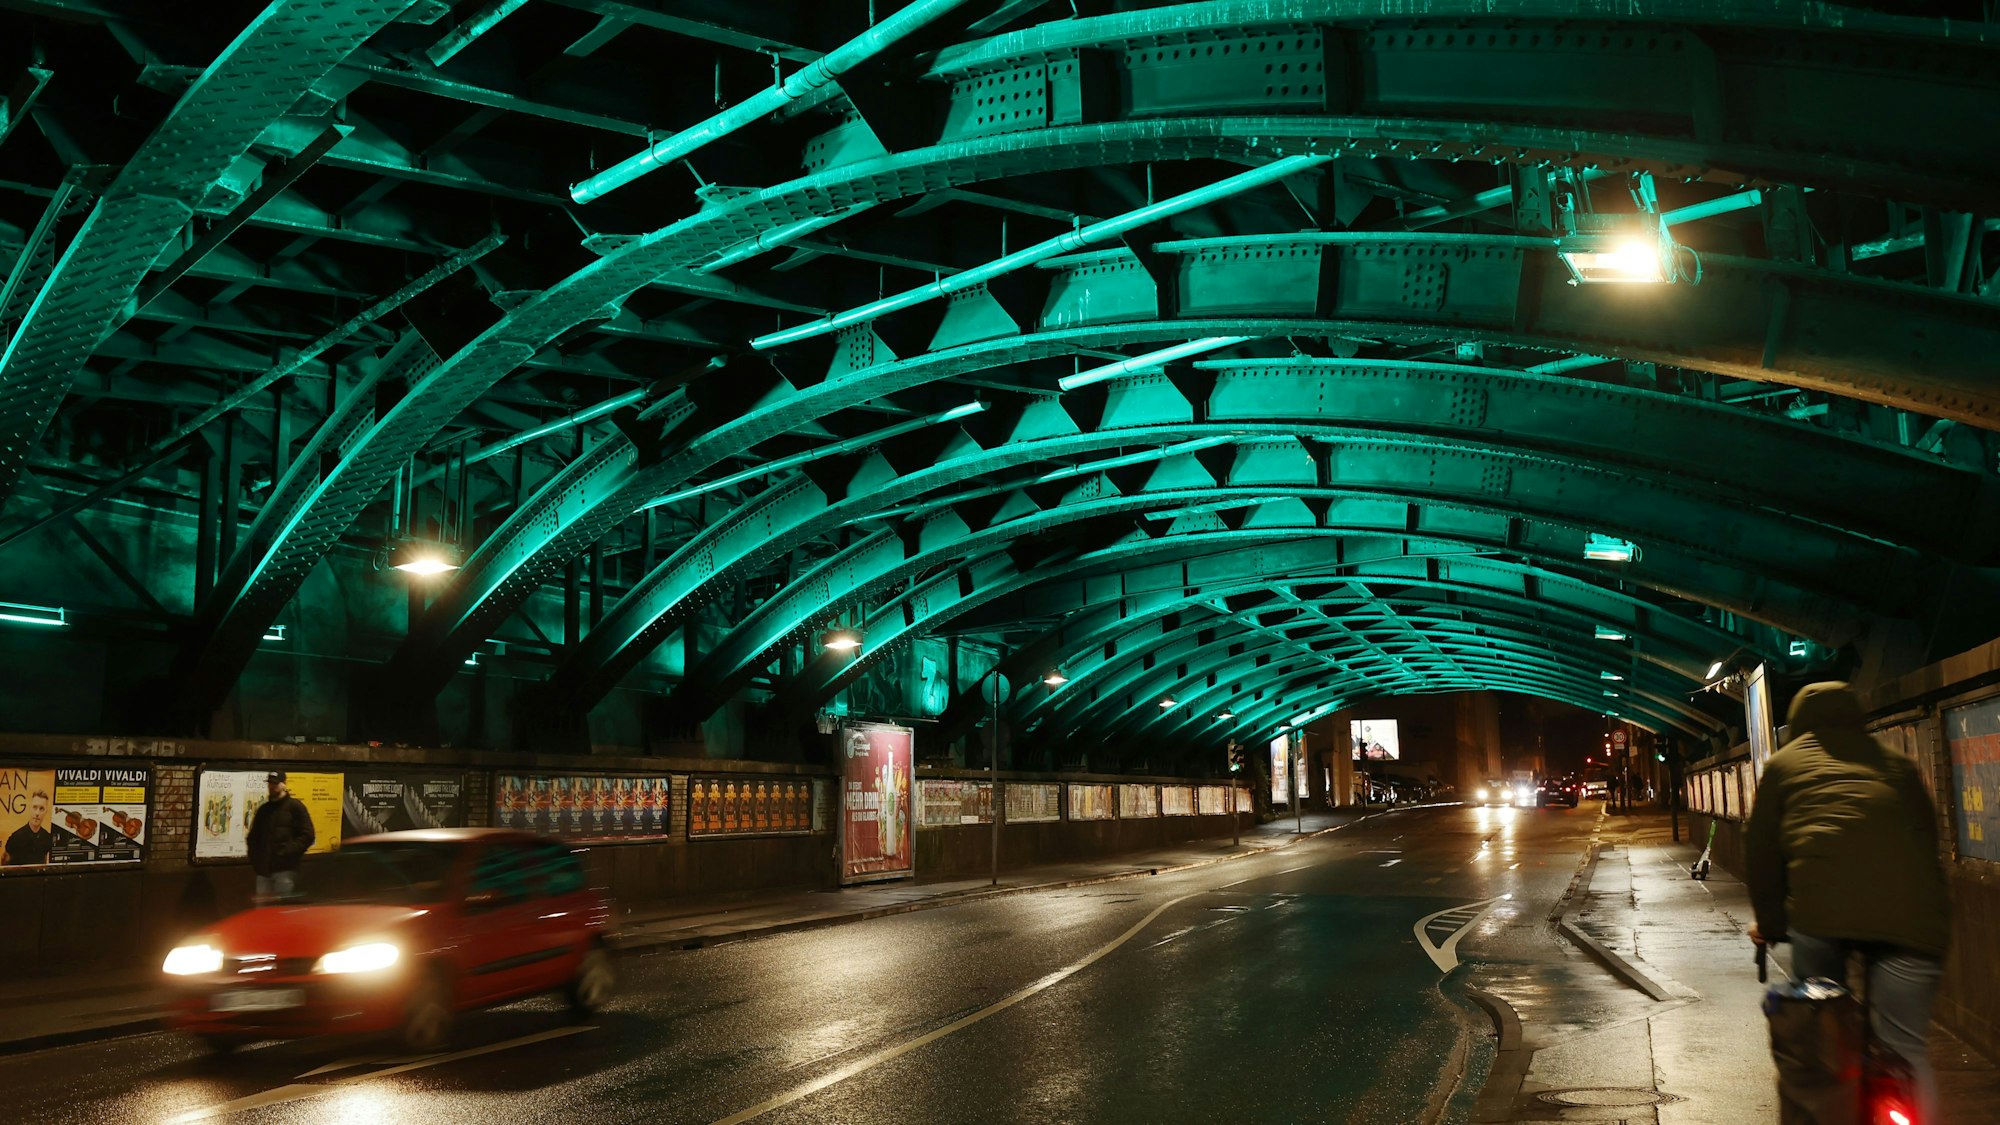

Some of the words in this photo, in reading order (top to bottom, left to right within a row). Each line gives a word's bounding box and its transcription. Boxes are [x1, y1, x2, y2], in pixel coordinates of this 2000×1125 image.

[1615, 733, 1623, 741] 30
[57, 769, 102, 781] VIVALDI
[105, 769, 147, 782] VIVALDI
[846, 791, 864, 810] MEHR
